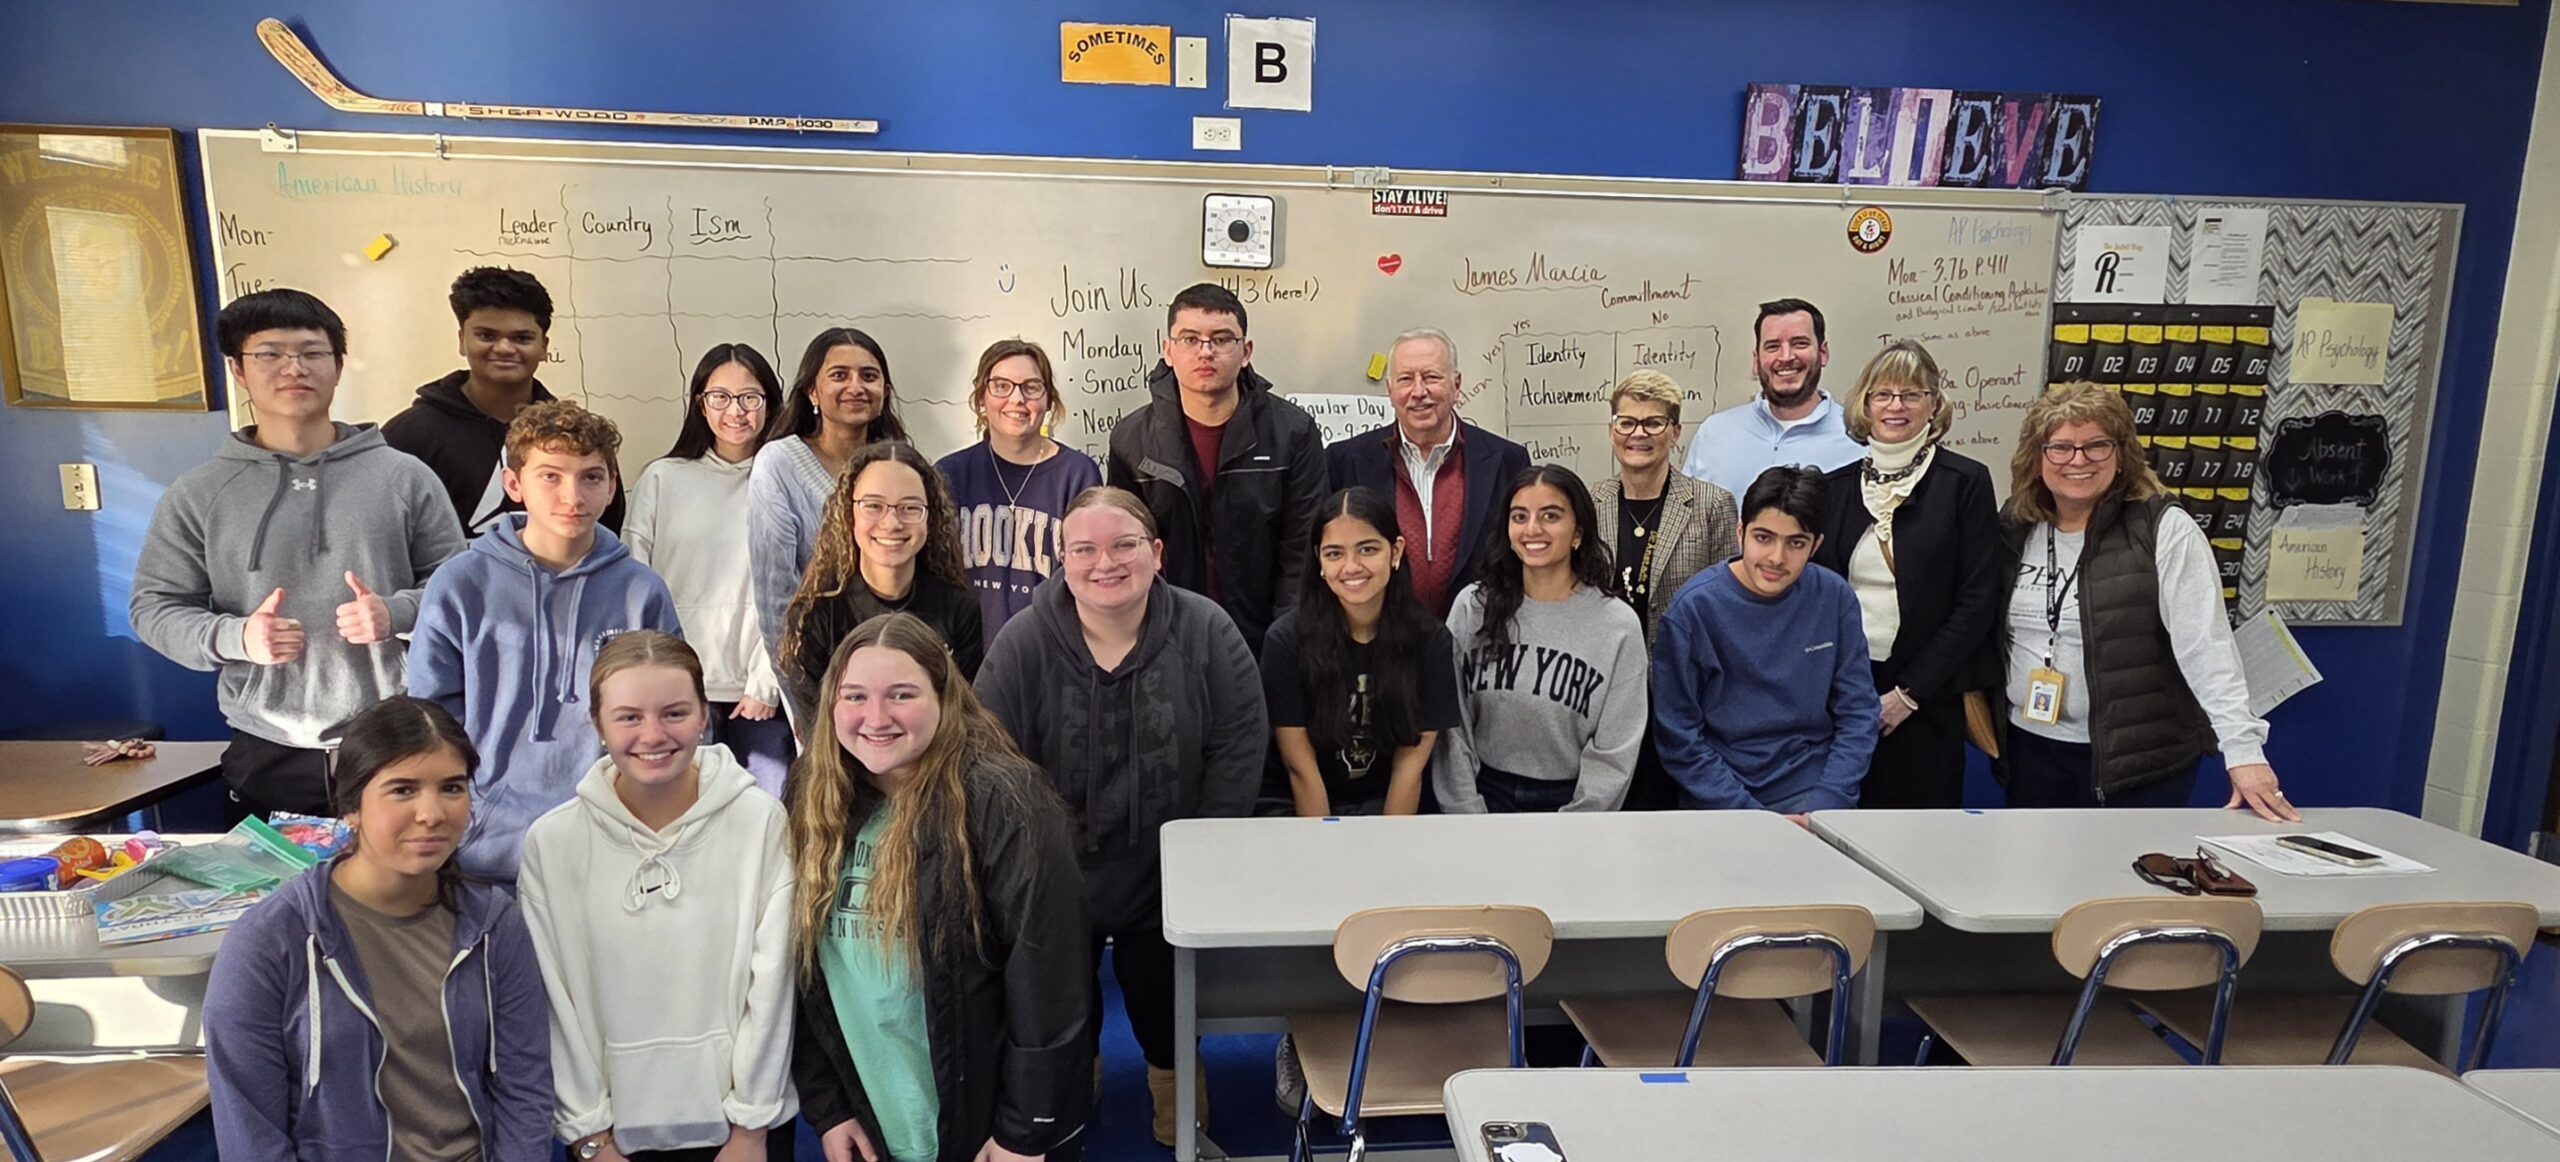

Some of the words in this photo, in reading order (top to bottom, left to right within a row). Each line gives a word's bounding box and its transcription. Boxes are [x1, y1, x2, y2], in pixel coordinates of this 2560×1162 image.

[1069, 31, 1165, 65] SOMETIMES
[1255, 42, 1287, 83] B
[1744, 89, 2093, 187] BELIEVE
[279, 161, 377, 199] American
[393, 165, 463, 196] History
[1374, 190, 1404, 203] STAY
[1406, 190, 1447, 205] ALIVE!
[1375, 204, 1396, 213] don't
[1397, 206, 1413, 214] TXT
[1414, 206, 1421, 214] &
[1422, 207, 1444, 215] drive
[219, 211, 274, 247] Mon-
[500, 208, 558, 234] Leader
[582, 206, 653, 252] Country
[690, 208, 743, 237] Ism
[1948, 217, 1969, 245] AP
[1453, 257, 1518, 293] James
[1526, 251, 1608, 285] Marcia
[1888, 257, 1928, 287] Mon-
[1933, 256, 1969, 284] 3.7b
[2095, 251, 2120, 294] R
[1050, 264, 1111, 318] Join
[1889, 285, 1938, 306] Classical
[1942, 283, 2006, 311] Conditioning
[1652, 309, 1669, 325] No
[1896, 308, 1913, 322] and
[1965, 325, 1992, 337] above
[1063, 328, 1144, 375] Monday
[1525, 338, 1587, 370] Identity
[1632, 340, 1696, 369] Identity
[2296, 329, 2317, 359] AP
[2320, 329, 2380, 370] Psychology
[2064, 356, 2084, 373] 01
[2102, 356, 2124, 373] 02
[2137, 357, 2158, 374] 03
[2174, 355, 2197, 373] 04
[2210, 356, 2233, 374] 05
[2246, 358, 2268, 376] 06
[1519, 377, 1613, 407] Achievement
[1965, 362, 2027, 402] Operant
[1357, 397, 1386, 421] Day
[2134, 407, 2155, 424] 09
[2169, 408, 2189, 425] 10
[2204, 407, 2222, 424] 11
[2240, 408, 2260, 425] 12
[1971, 431, 2001, 445] above
[2298, 437, 2367, 462] Absent
[2165, 461, 2186, 478] 16
[2201, 461, 2222, 478] 17
[2233, 462, 2254, 478] 18
[2224, 514, 2245, 529] 24
[2278, 533, 2328, 554] American
[2221, 562, 2241, 576] 30
[2303, 556, 2346, 591] History
[974, 579, 1002, 591] NEW
[1011, 584, 1030, 594] YO
[1462, 643, 1530, 699] NEW
[1531, 646, 1605, 720] YORK
